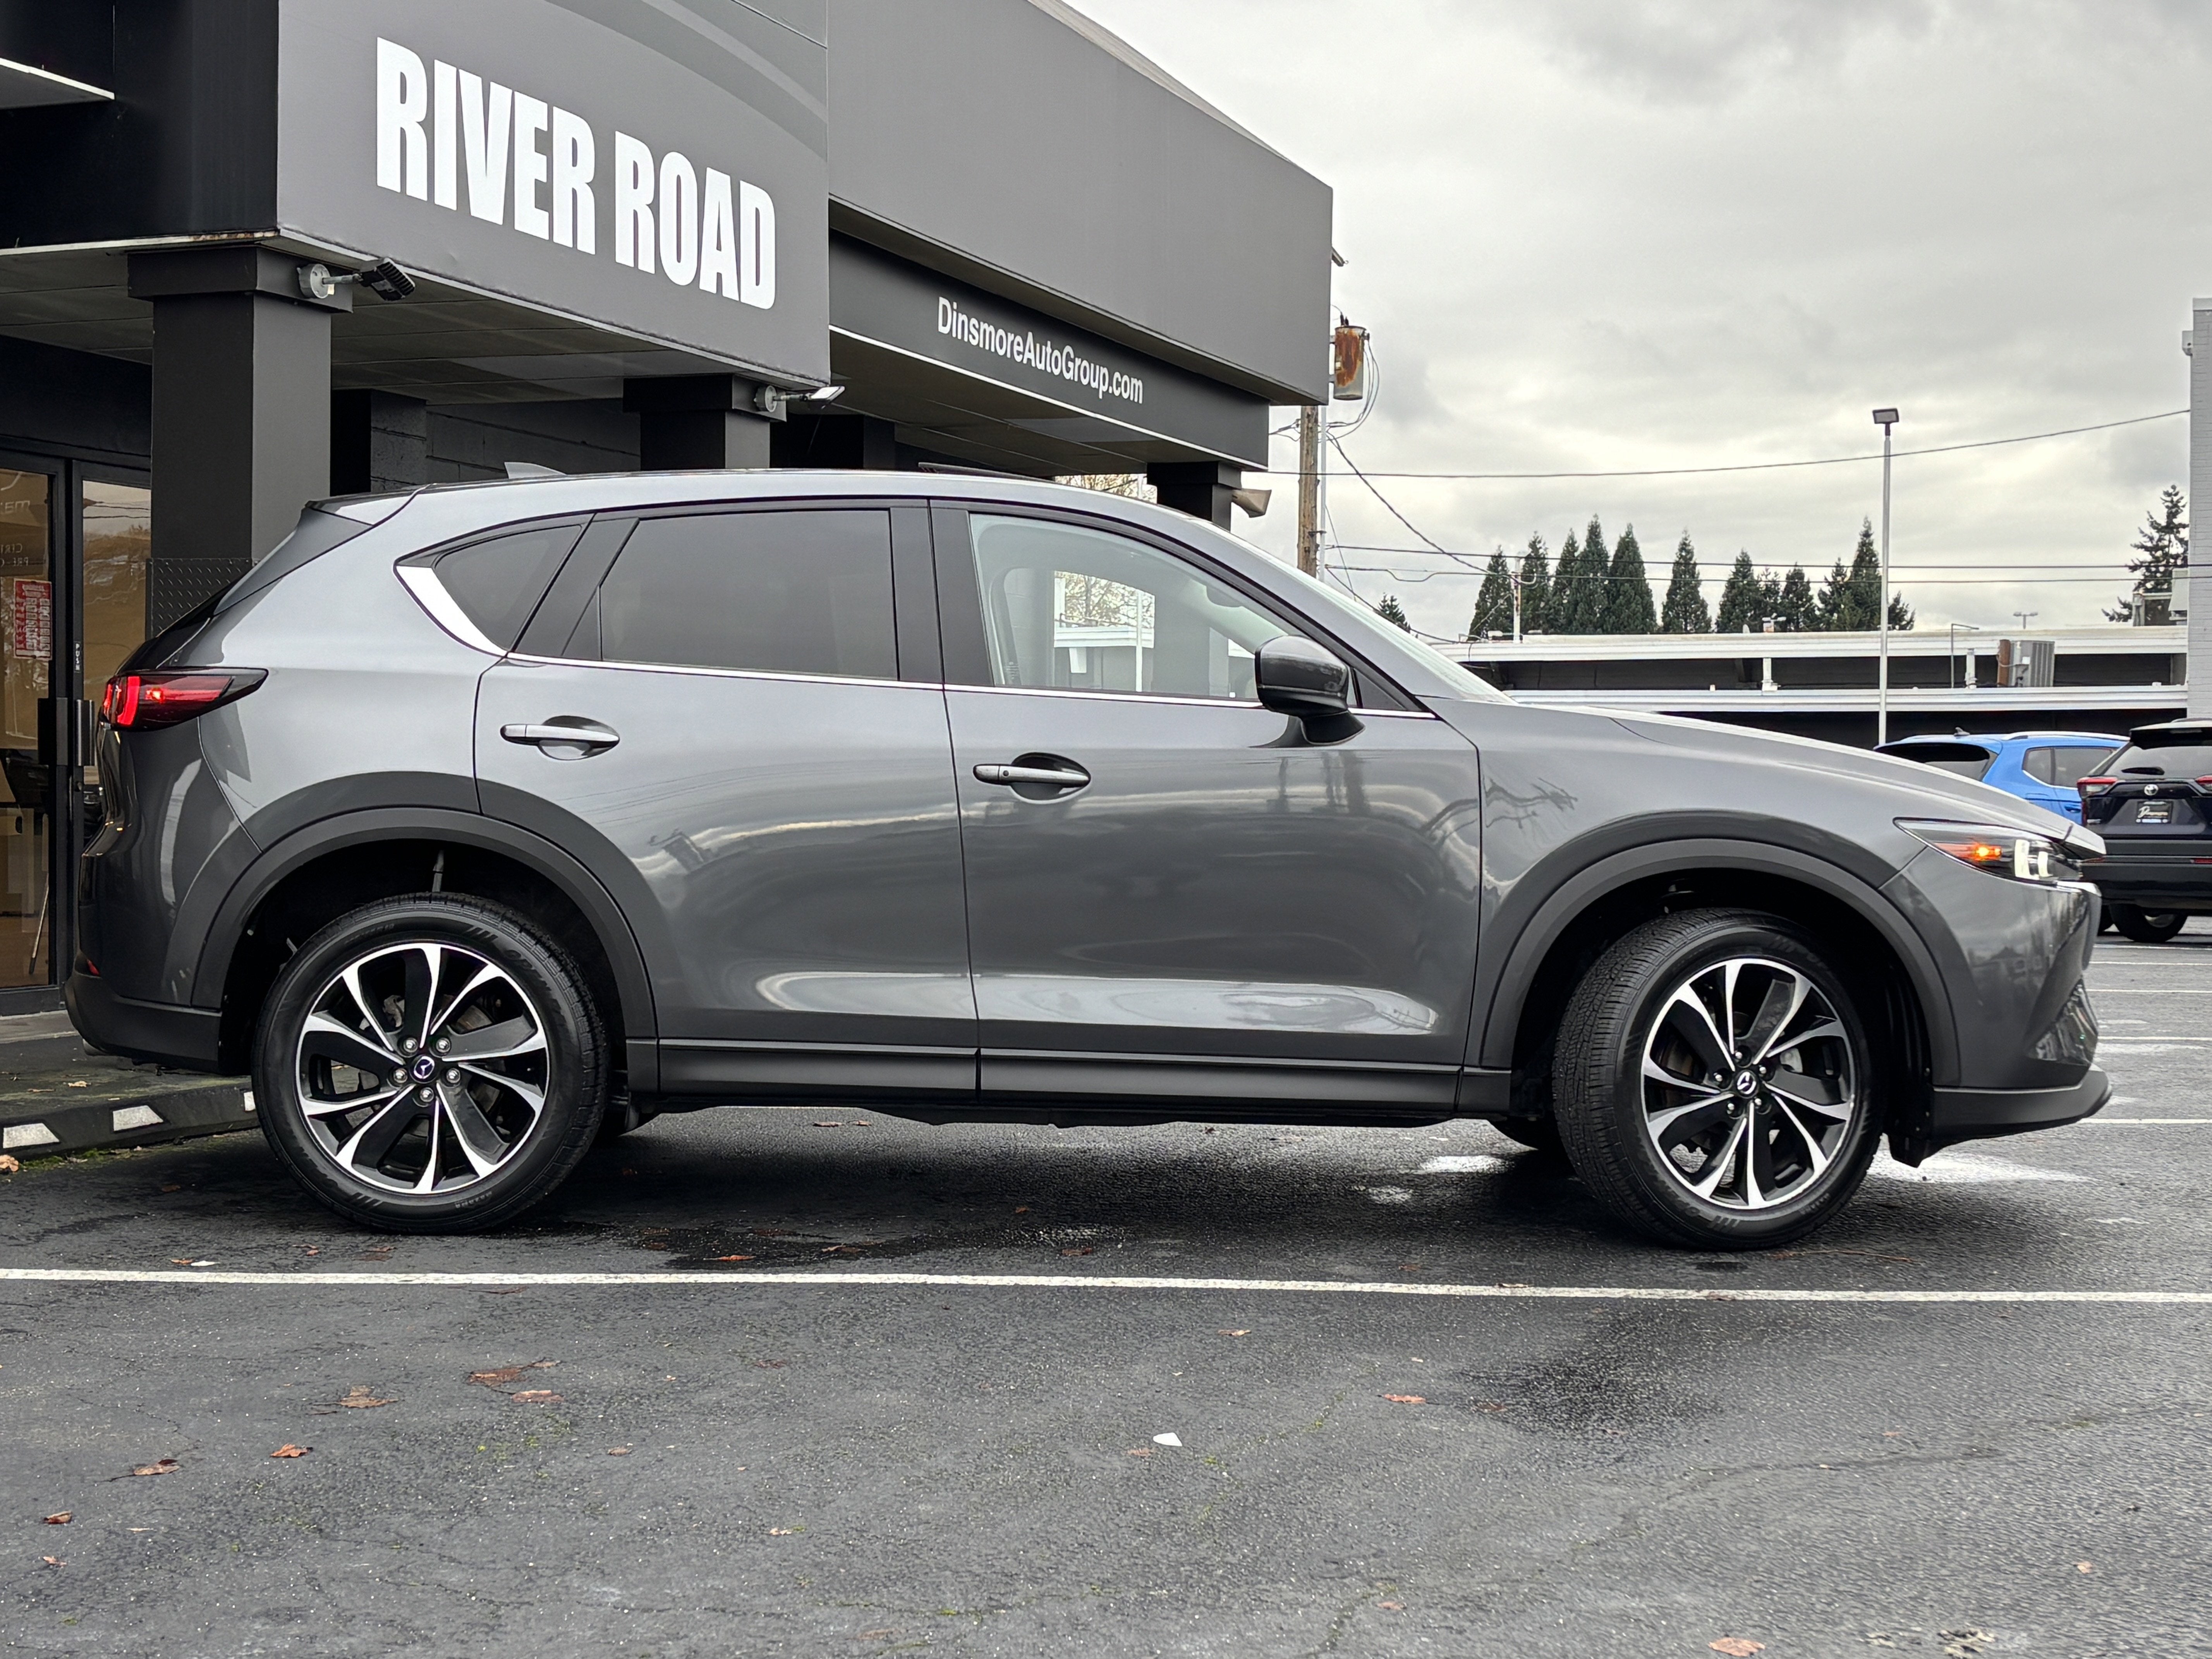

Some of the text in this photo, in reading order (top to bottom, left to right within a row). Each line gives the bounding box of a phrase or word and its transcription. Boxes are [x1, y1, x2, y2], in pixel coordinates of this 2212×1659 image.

[377, 36, 776, 310] RIVER ROAD
[938, 296, 1143, 404] DinsmoreAutoGroup.com
